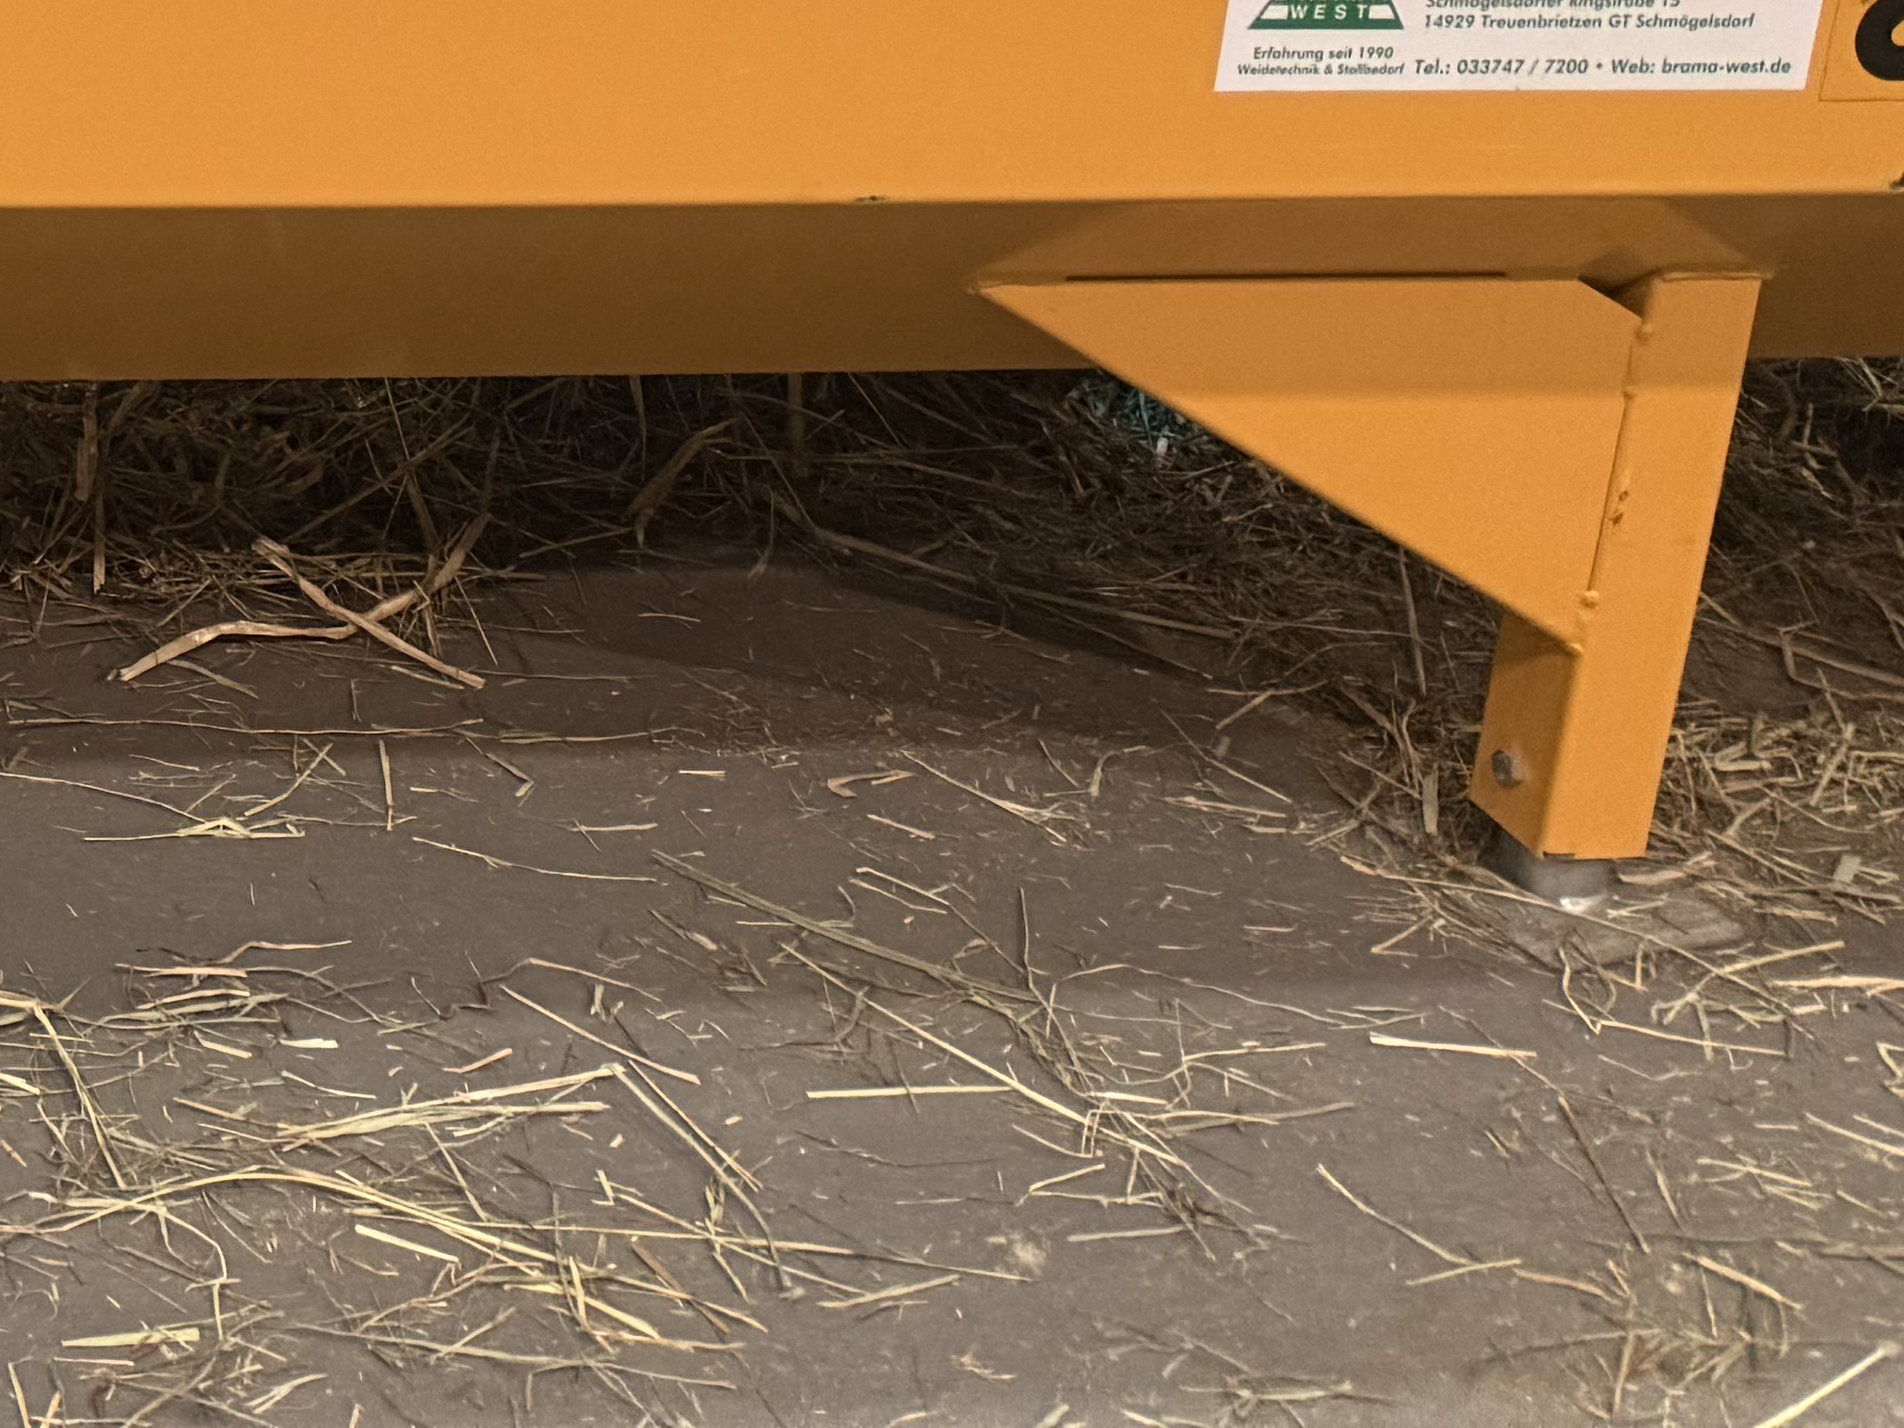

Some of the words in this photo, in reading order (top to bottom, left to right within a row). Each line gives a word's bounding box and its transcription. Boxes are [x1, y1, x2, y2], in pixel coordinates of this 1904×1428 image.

[1290, 4, 1370, 20] WEST
[1423, 14, 1475, 29] 14929
[1253, 46, 1324, 62] Erfahrung
[1328, 46, 1353, 60] seit
[1359, 46, 1394, 60] 1990
[1414, 58, 1452, 75] Tel.:
[1456, 58, 1525, 75] 033747
[1544, 58, 1589, 75] 7200
[1611, 57, 1656, 75] Web:
[1661, 58, 1792, 75] brama-west.de
